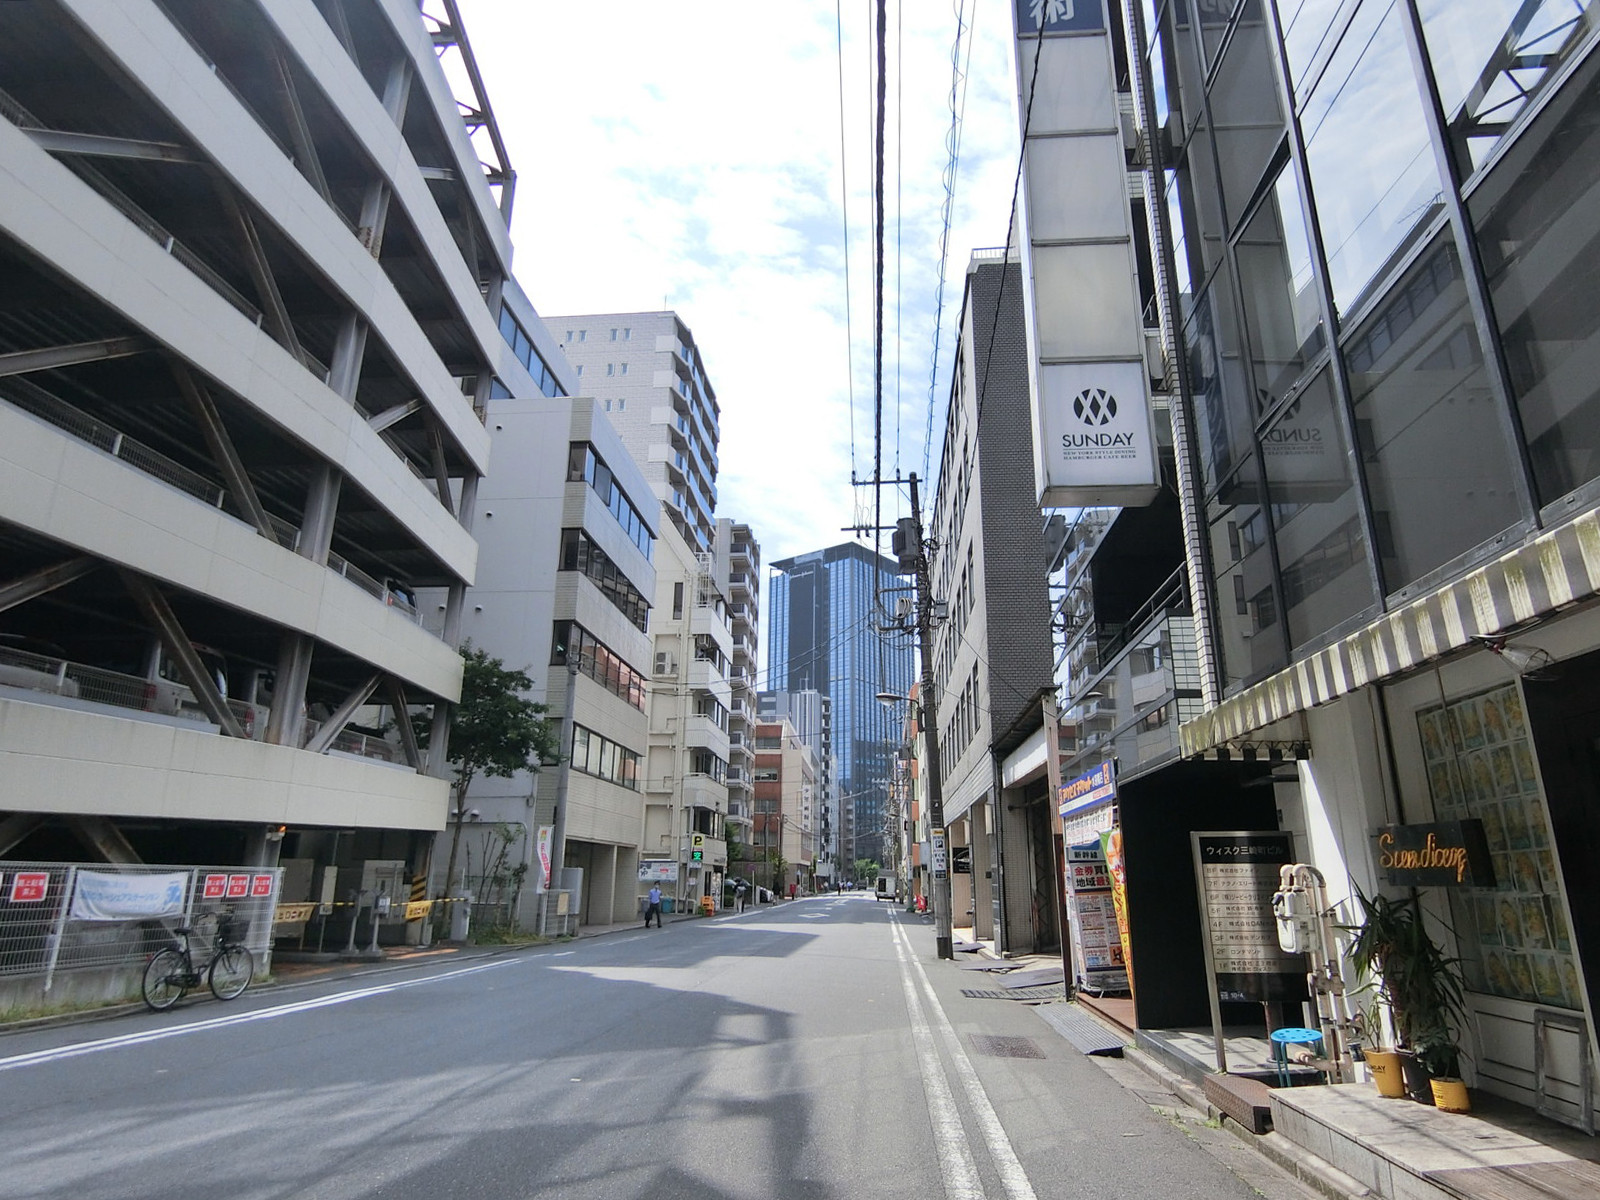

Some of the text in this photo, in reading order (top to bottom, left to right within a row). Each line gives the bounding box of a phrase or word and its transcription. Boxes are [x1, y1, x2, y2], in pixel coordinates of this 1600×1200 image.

[1062, 432, 1134, 448] SUNDAY
[694, 836, 702, 846] P
[1074, 851, 1098, 859] 新幹線
[1206, 845, 1283, 856] ウィスク三崎町ビル
